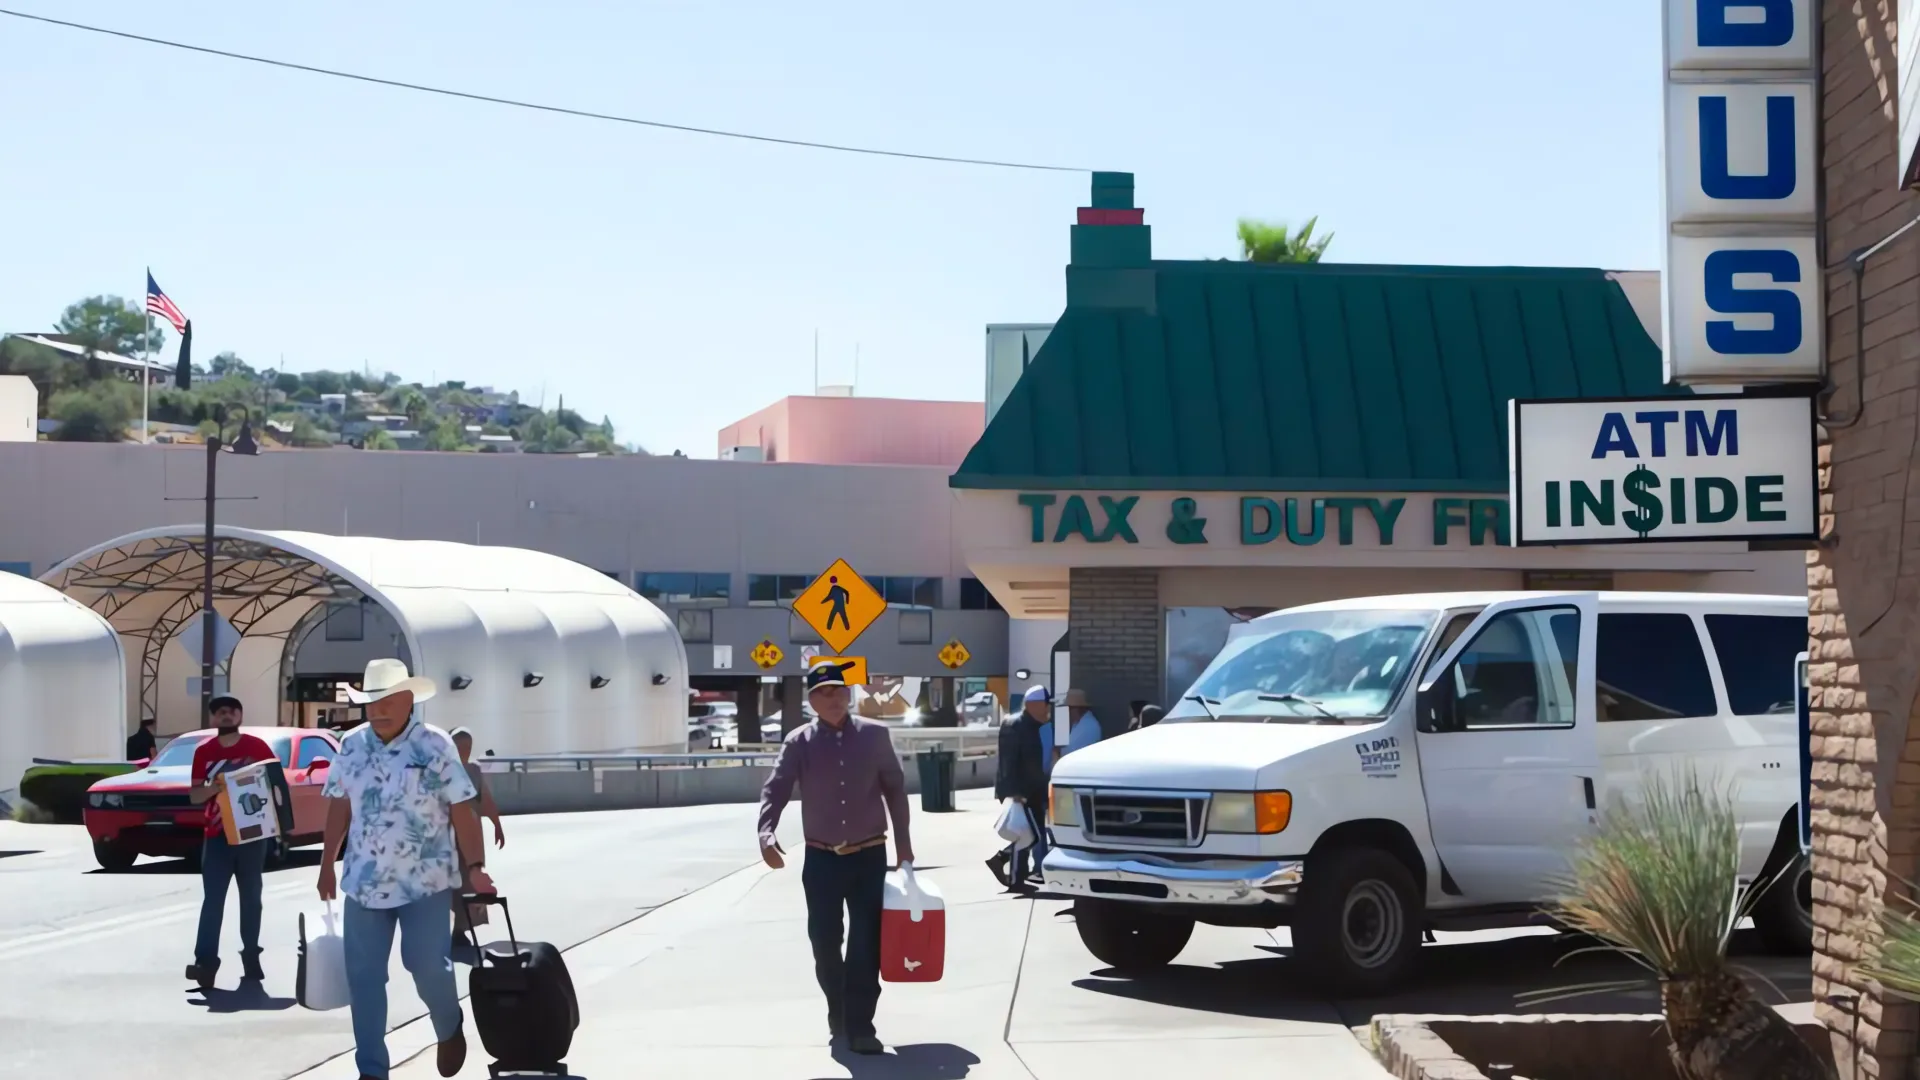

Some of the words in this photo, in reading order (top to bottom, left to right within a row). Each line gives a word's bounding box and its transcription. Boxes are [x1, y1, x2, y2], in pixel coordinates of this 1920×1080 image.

[1591, 409, 1739, 459] ATM
[1018, 493, 1140, 544] TAX
[1166, 497, 1208, 544] &
[1240, 496, 1407, 546] DUTY
